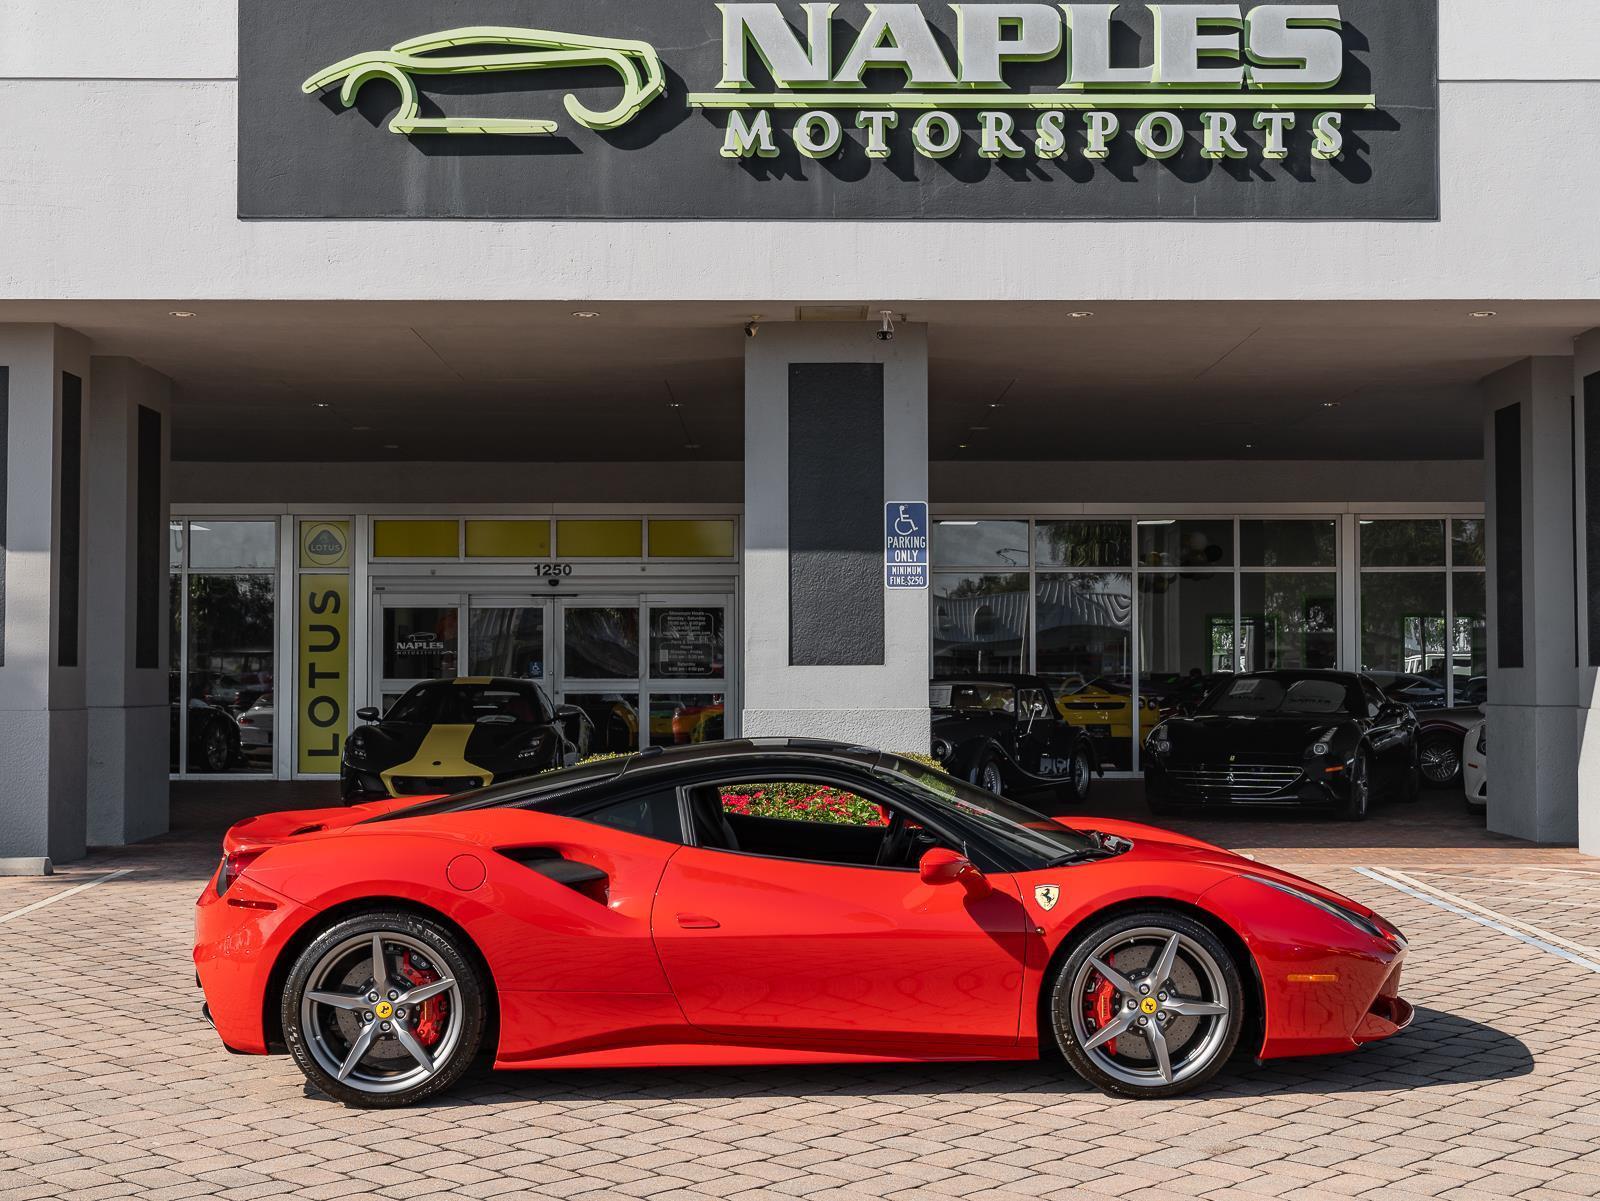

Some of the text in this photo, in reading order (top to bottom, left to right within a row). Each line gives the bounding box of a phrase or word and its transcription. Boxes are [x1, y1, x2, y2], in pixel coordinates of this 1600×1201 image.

[714, 2, 1344, 89] NAPLES
[720, 108, 1344, 159] MOTORSPORTS
[311, 544, 341, 552] LOTUS
[888, 537, 925, 548] PARKING
[895, 550, 919, 562] ONLY
[533, 563, 573, 577] 1250
[892, 566, 922, 575] MINIMUM
[890, 575, 924, 586] FINE $250
[396, 642, 444, 650] NAPLES
[308, 589, 341, 757] LOTUS
